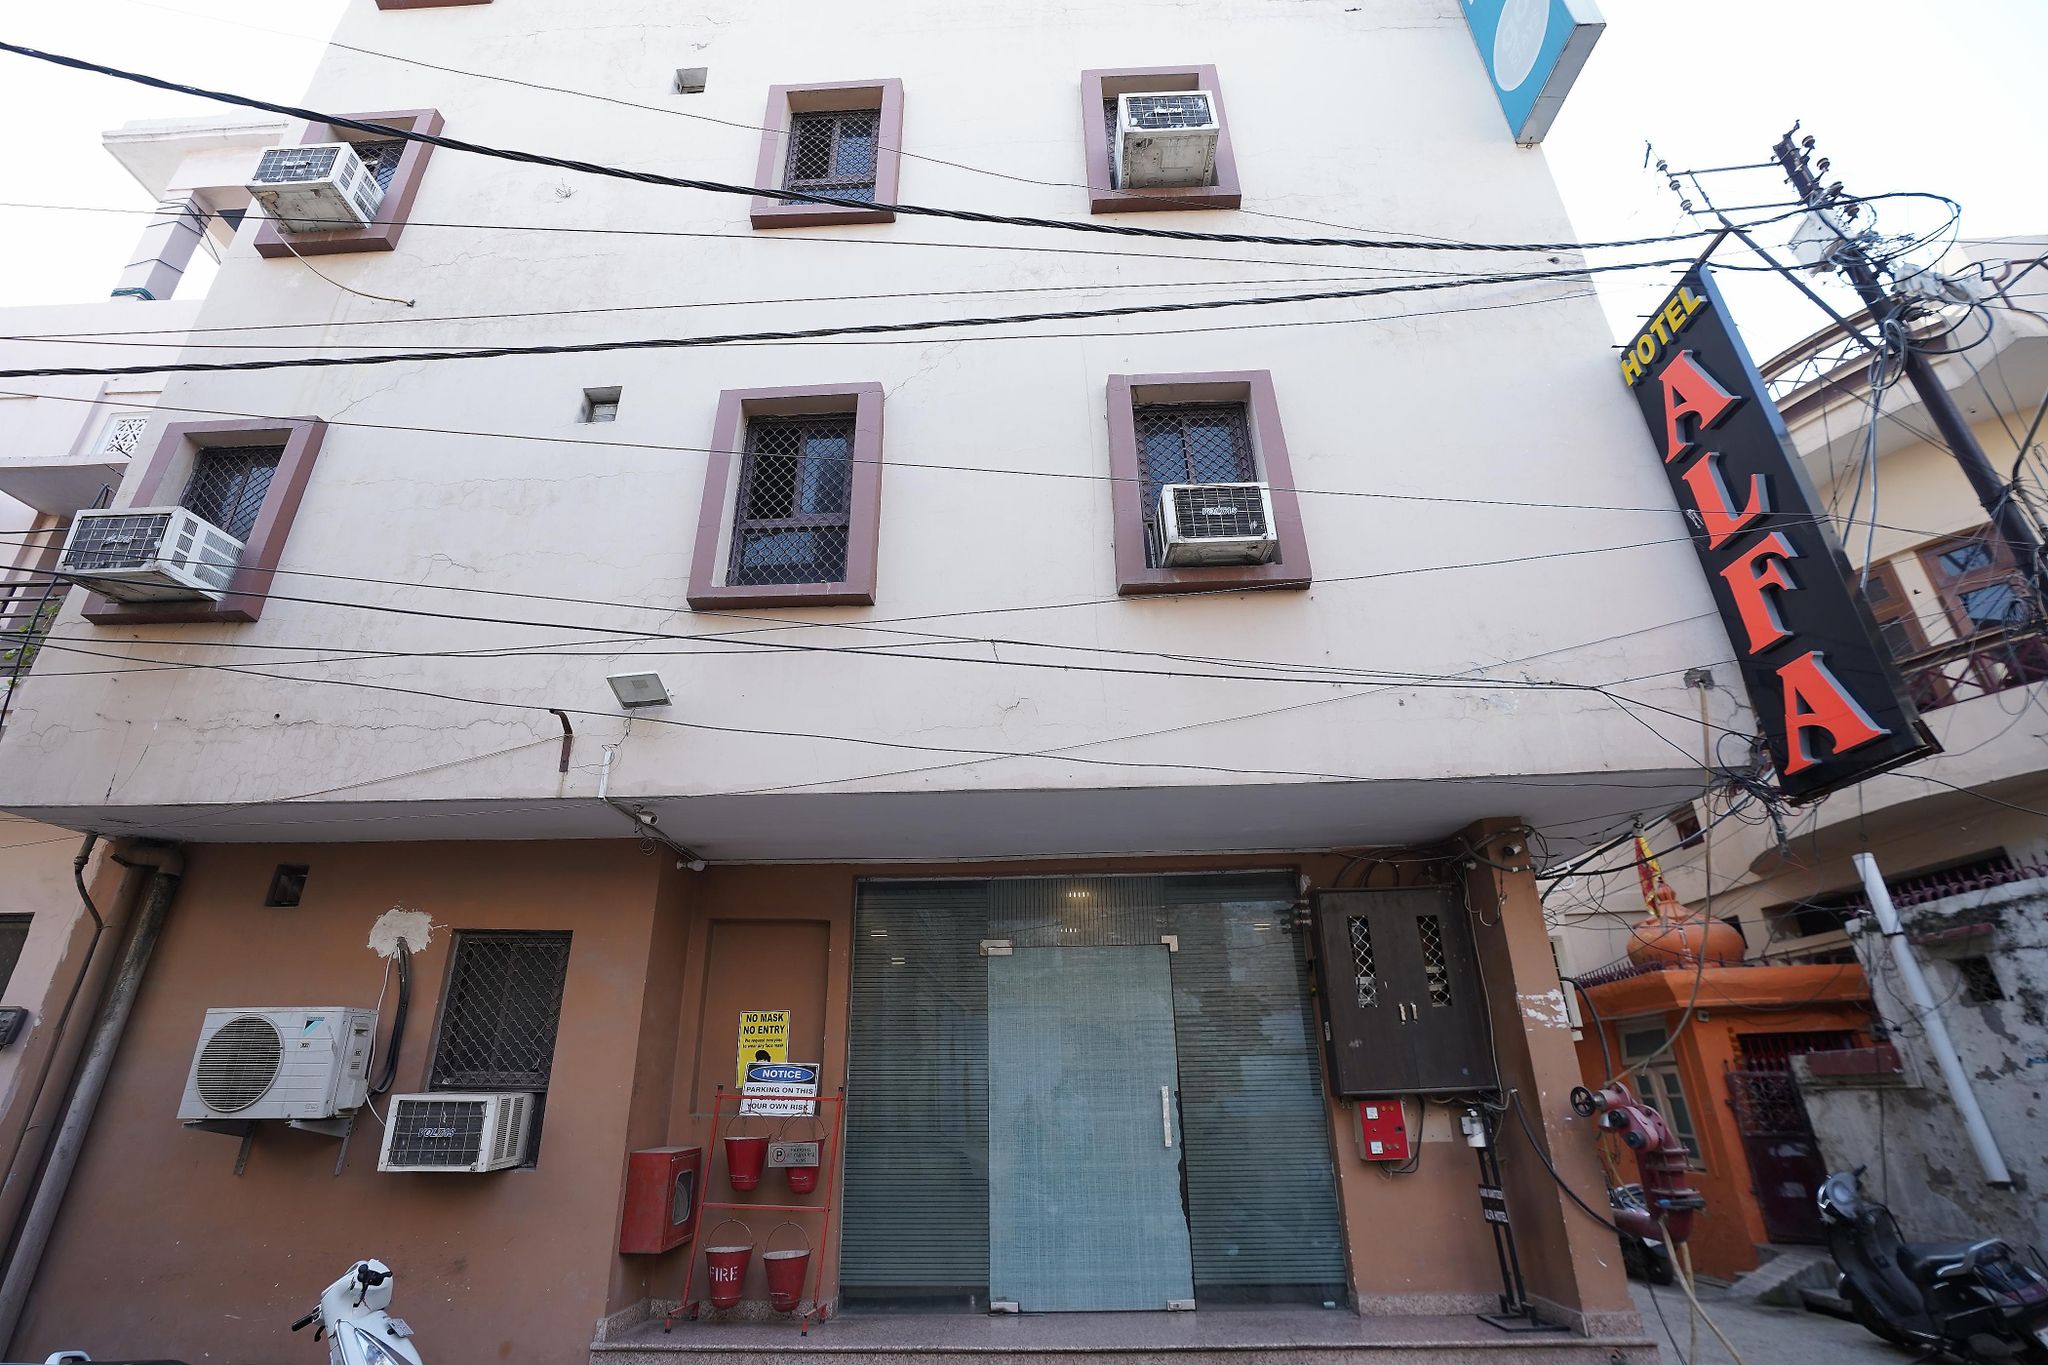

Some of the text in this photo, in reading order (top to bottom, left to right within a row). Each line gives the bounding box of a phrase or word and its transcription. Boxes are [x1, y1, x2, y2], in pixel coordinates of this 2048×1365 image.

[1621, 286, 1706, 387] HOTEL
[1658, 348, 1891, 777] ALFA
[746, 1013, 784, 1023] NO MASK
[743, 1025, 786, 1035] NO ENTRY
[762, 1069, 802, 1079] NOTICE
[746, 1086, 780, 1094] PARKING
[417, 1127, 456, 1138] VOLTAS
[709, 1265, 739, 1282] FIRE
